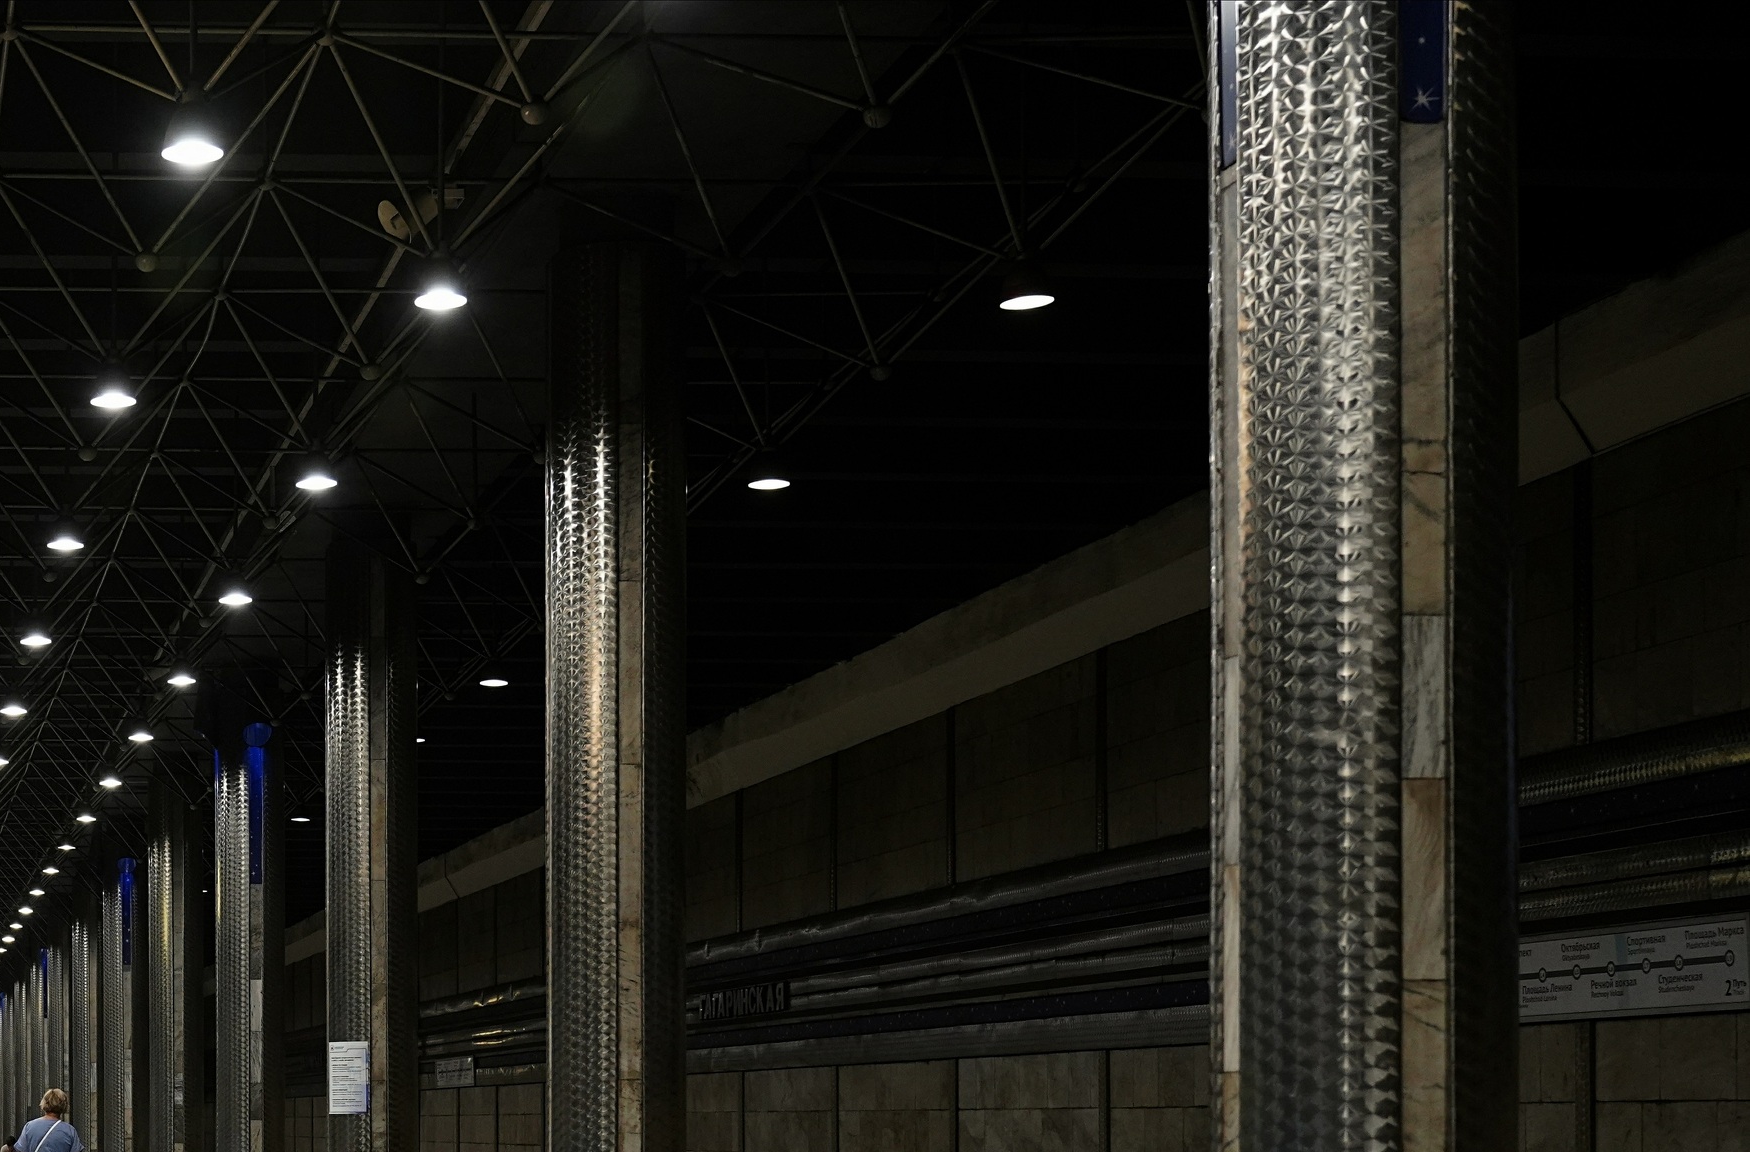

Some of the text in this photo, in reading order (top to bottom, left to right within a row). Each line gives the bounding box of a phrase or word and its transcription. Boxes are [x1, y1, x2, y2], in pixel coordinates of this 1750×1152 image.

[1684, 926, 1745, 940] Площадь Маркса
[1626, 935, 1666, 946] Спортивная
[1561, 942, 1600, 954] Октябрьская
[1590, 977, 1638, 990] Речной вокзал
[1658, 972, 1704, 986] Студенческая
[1522, 983, 1573, 995] Площадь Ленина
[1725, 979, 1733, 996] 2
[699, 982, 784, 1020] ГАГАРИНСКАЯ
